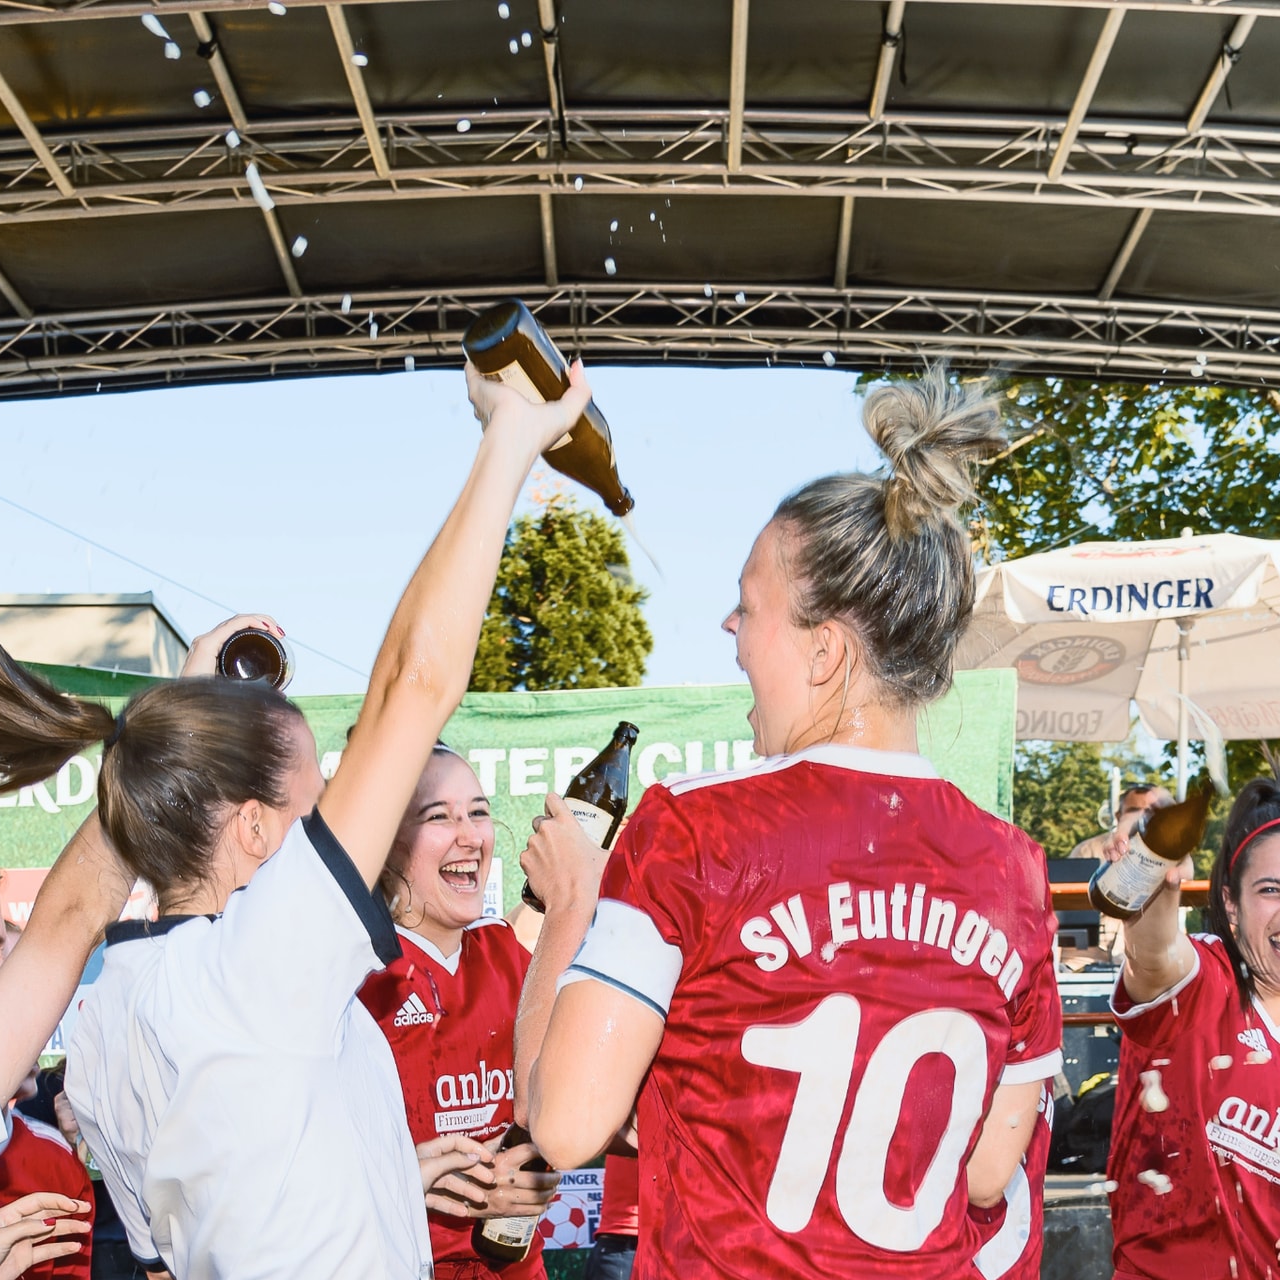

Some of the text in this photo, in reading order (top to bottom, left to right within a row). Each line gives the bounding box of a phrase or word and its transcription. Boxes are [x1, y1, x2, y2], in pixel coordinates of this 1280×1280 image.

[1047, 578, 1214, 615] ERDINGER
[740, 882, 1024, 1001] SV Eutingen
[394, 1011, 434, 1027] adidas
[741, 992, 988, 1252] 10
